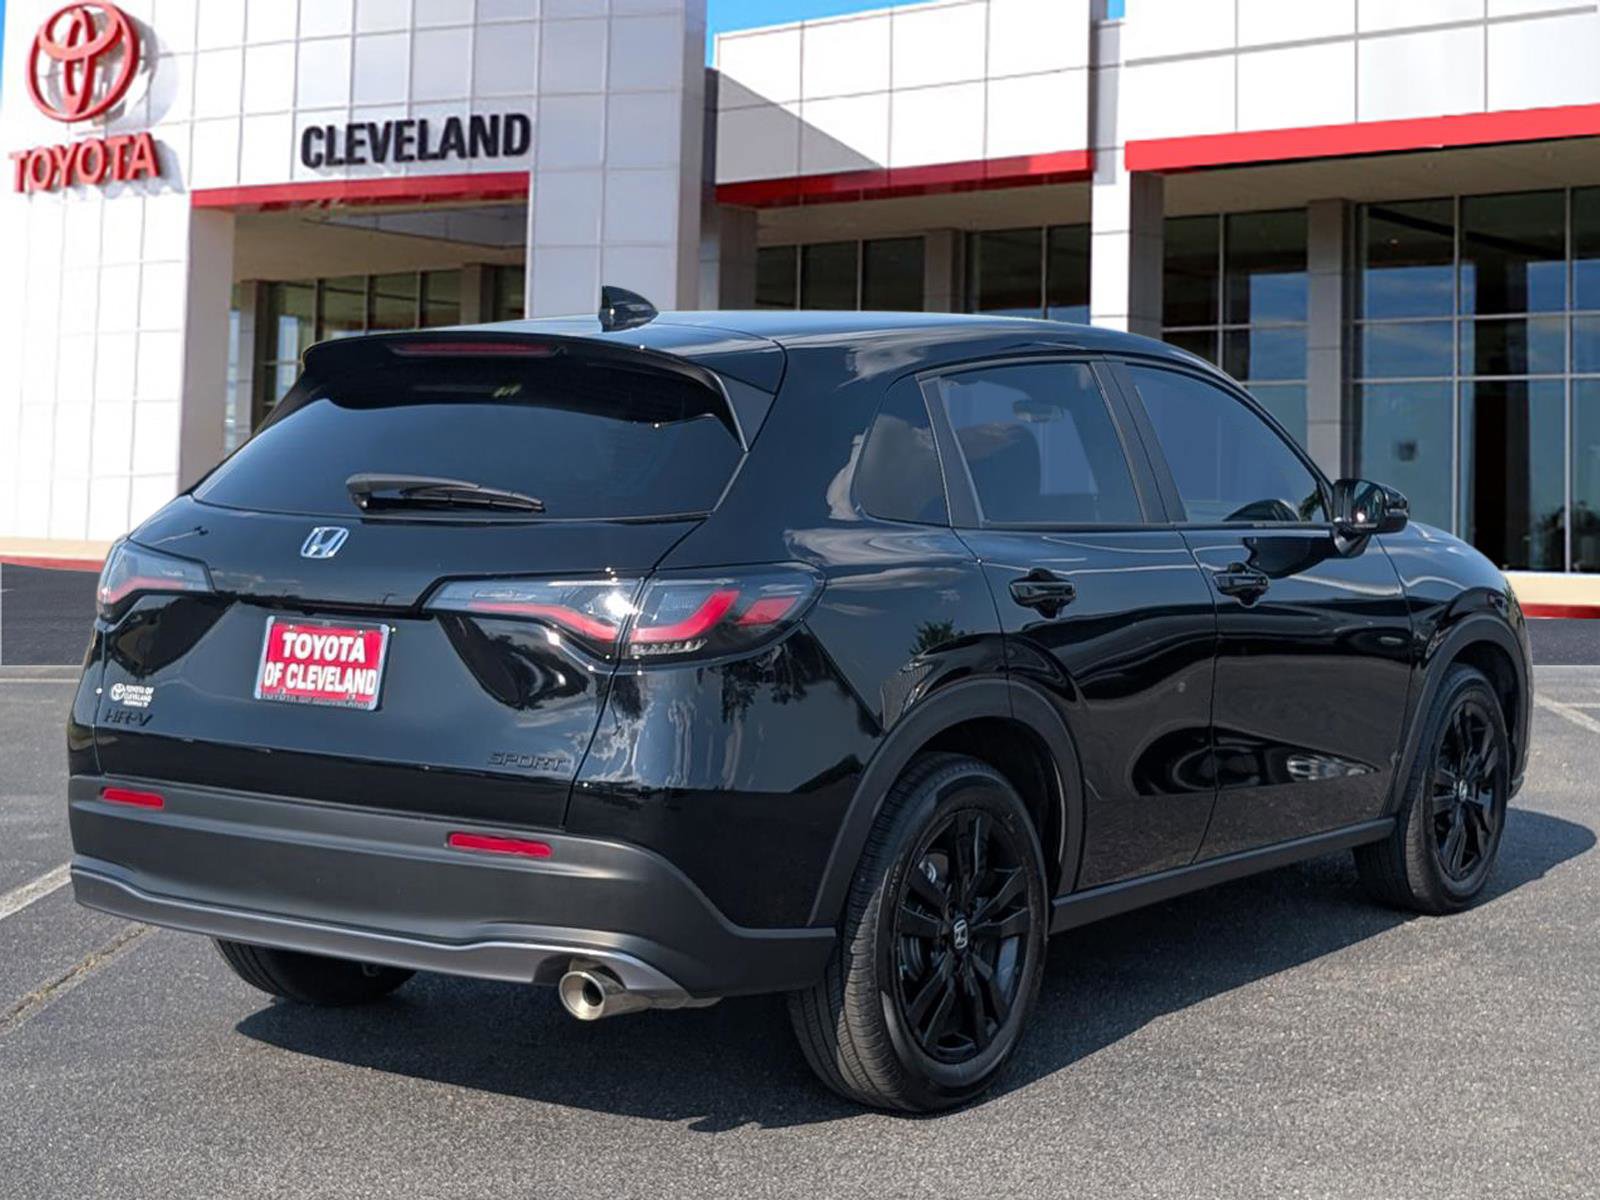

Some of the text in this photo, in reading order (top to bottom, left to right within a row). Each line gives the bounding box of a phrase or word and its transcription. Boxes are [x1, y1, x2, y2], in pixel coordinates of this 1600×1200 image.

[301, 113, 531, 169] CLEVELAND
[9, 132, 161, 193] TOYOTA
[282, 631, 366, 664] TOYOTA
[264, 661, 378, 696] OF CLEVELAND
[488, 752, 568, 771] SPORT
